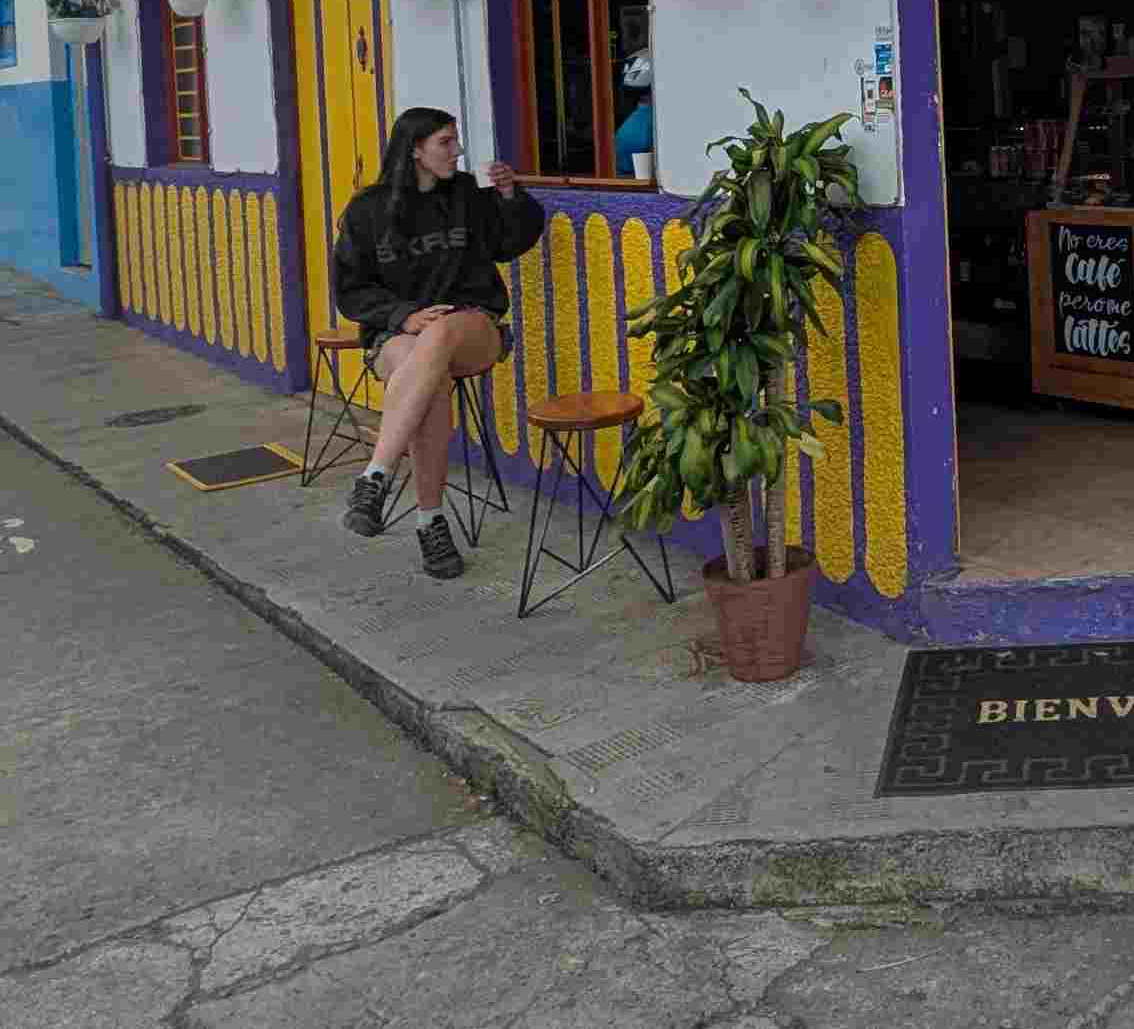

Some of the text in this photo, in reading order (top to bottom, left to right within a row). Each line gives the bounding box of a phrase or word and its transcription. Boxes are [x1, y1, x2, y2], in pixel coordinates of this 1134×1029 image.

[1059, 226, 1128, 251] No eres
[1065, 253, 1126, 291] Café
